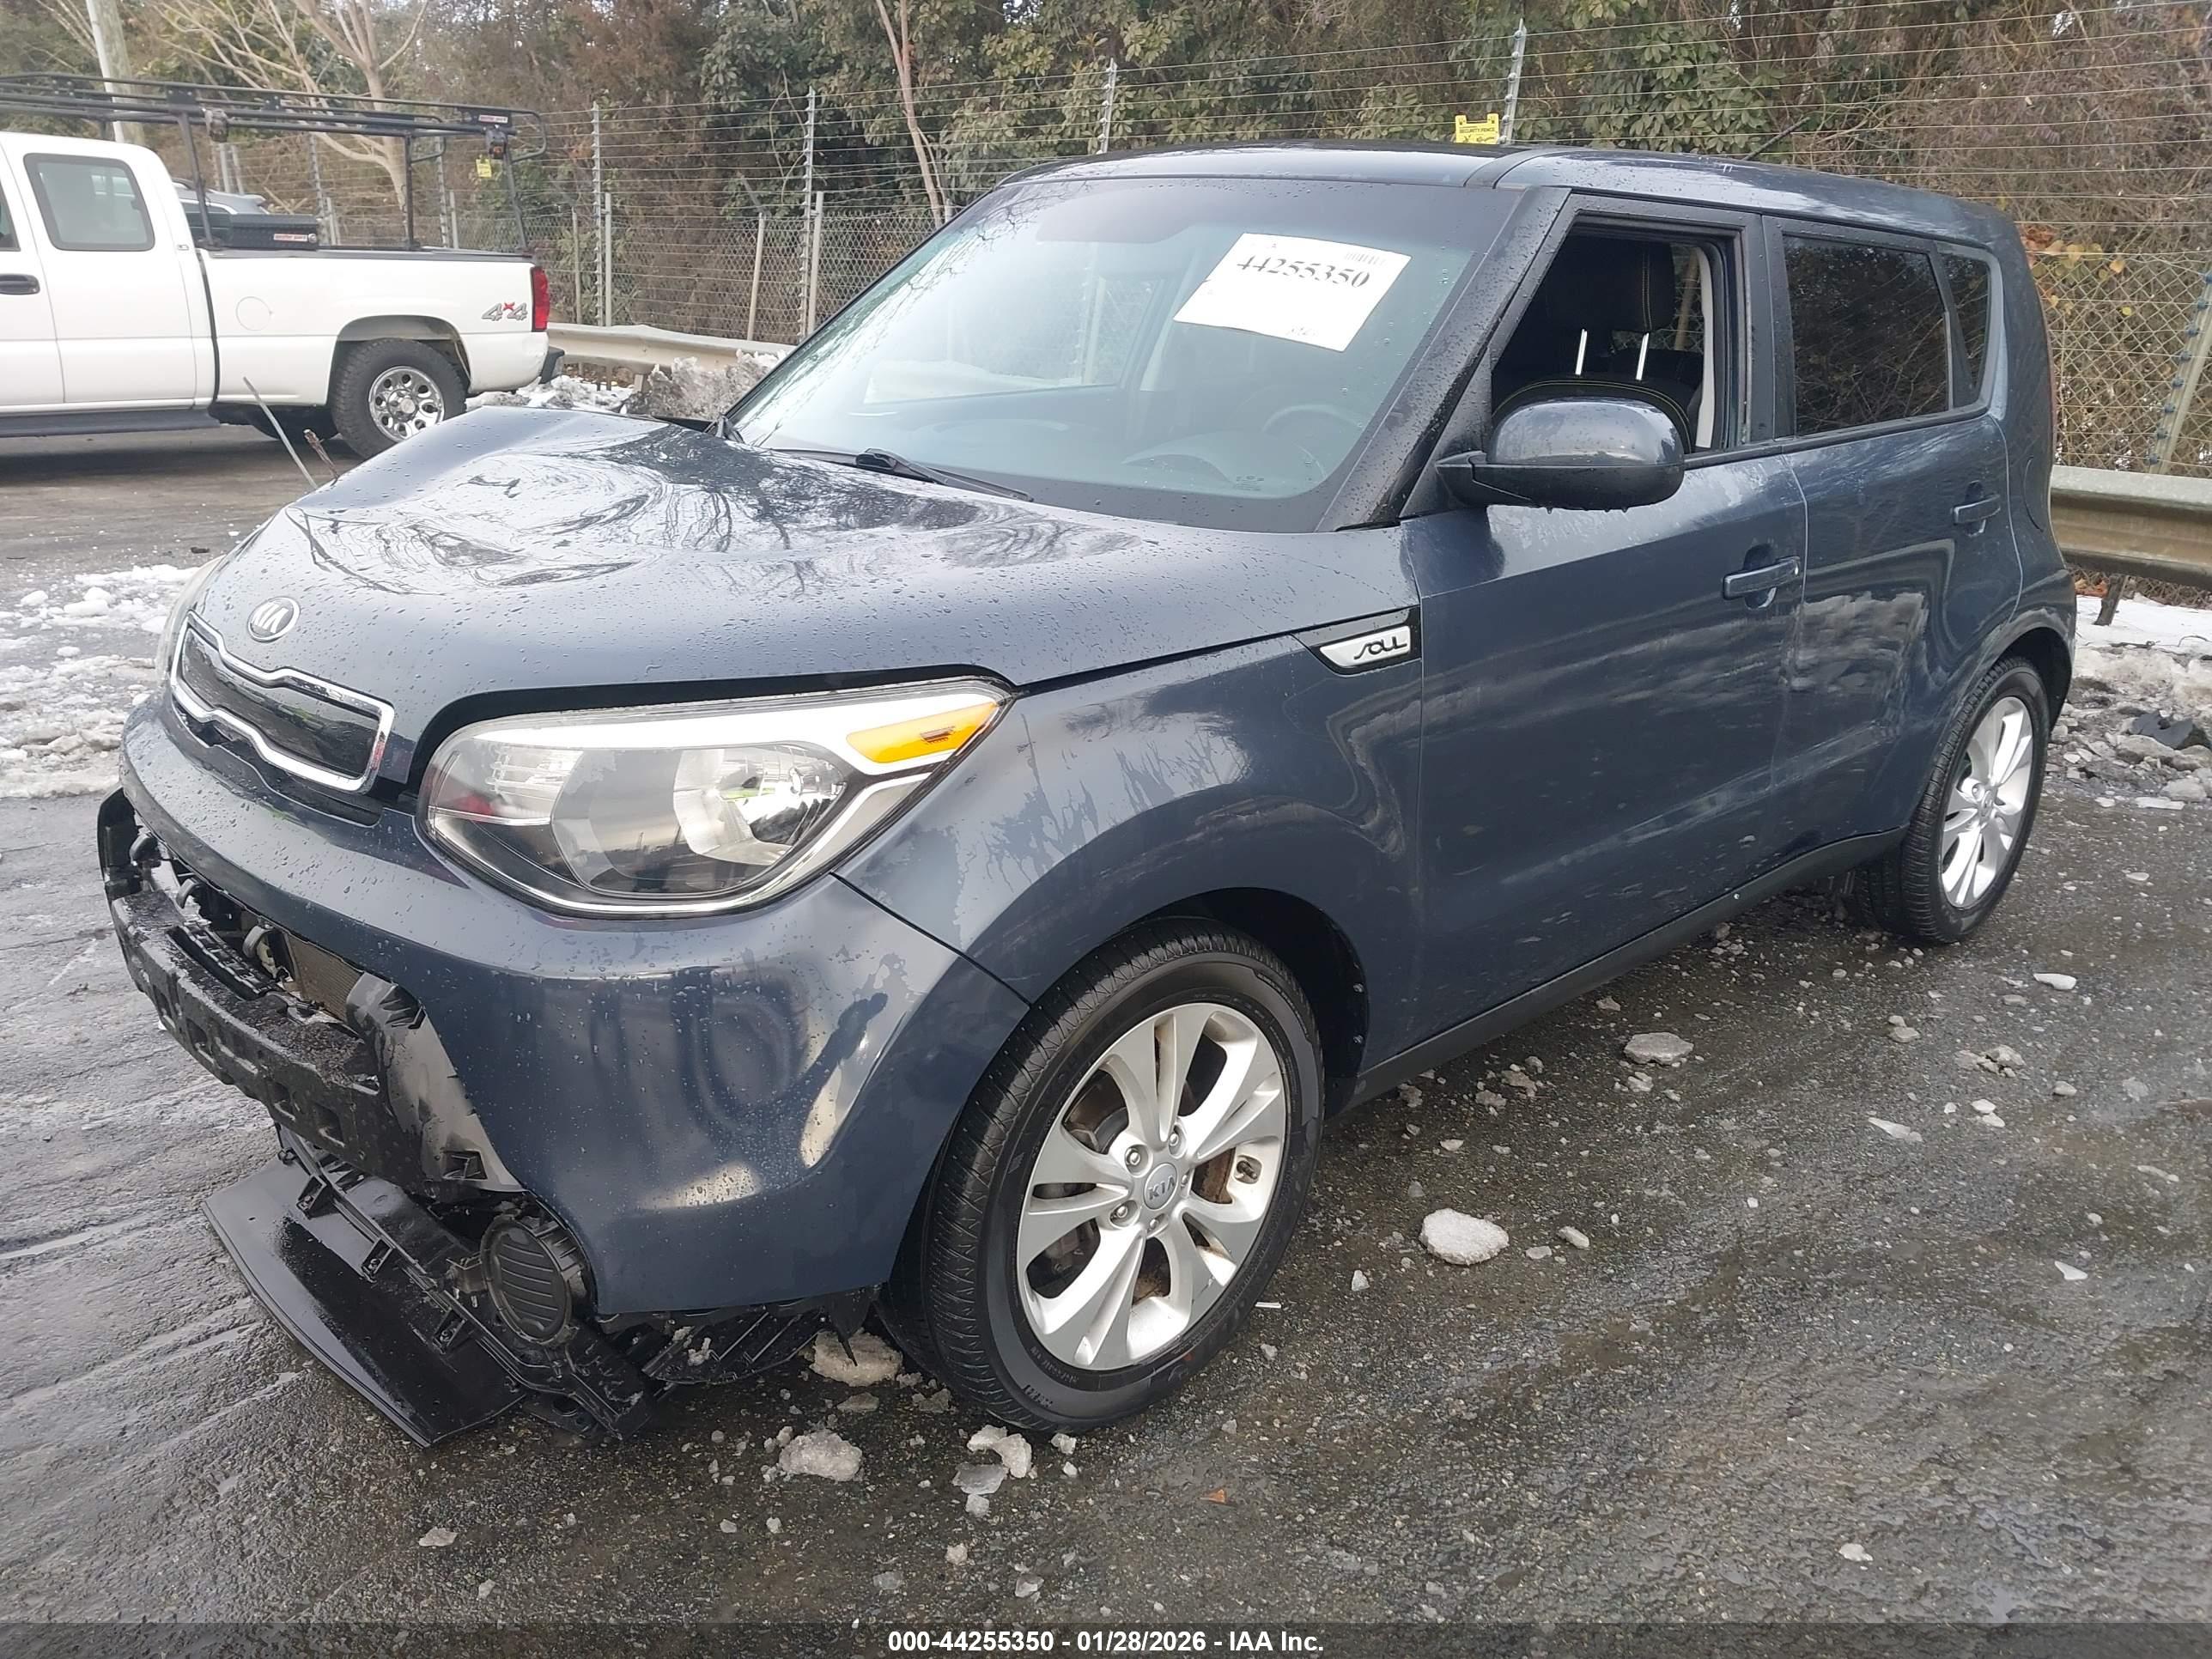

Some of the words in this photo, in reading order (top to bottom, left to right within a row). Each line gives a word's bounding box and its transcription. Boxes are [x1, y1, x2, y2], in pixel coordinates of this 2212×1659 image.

[1237, 255, 1370, 288] 44255350
[1353, 636, 1408, 660] SOUL
[1148, 1176, 1176, 1200] KIA
